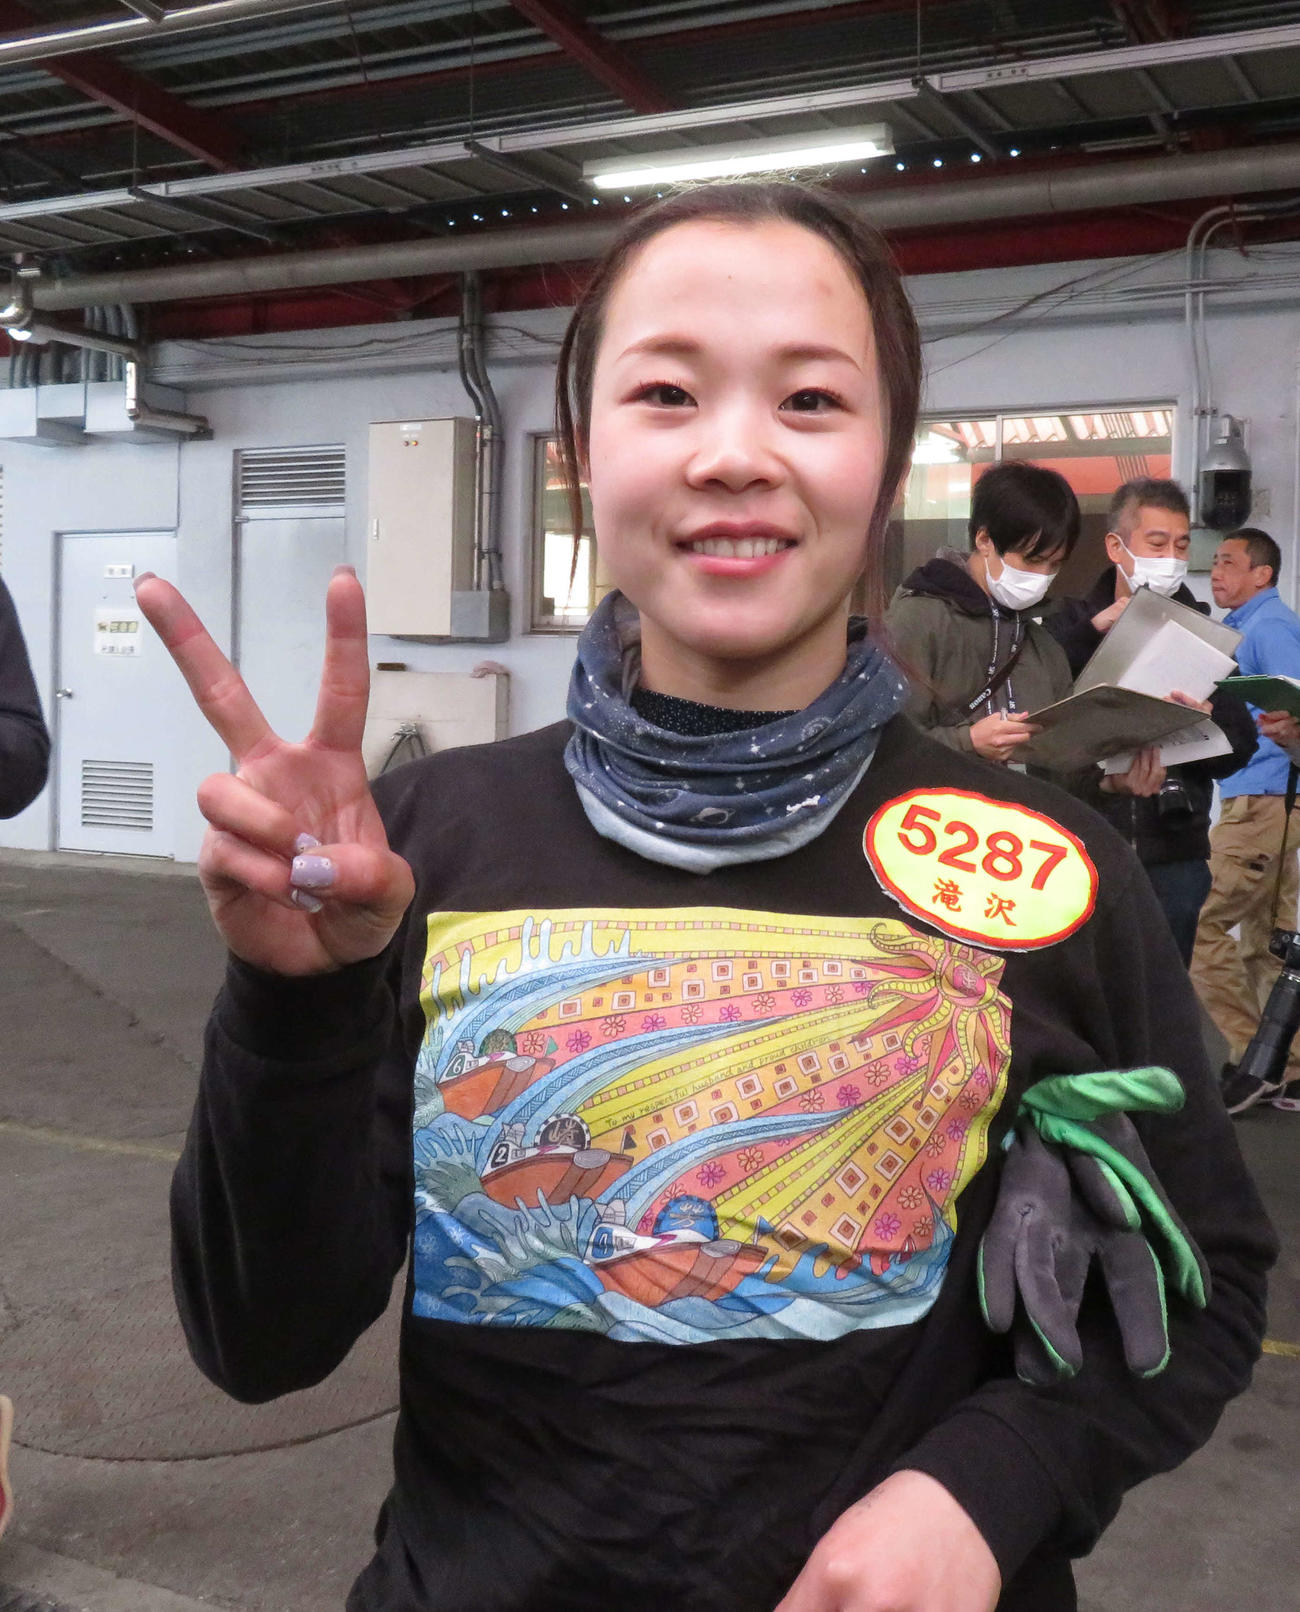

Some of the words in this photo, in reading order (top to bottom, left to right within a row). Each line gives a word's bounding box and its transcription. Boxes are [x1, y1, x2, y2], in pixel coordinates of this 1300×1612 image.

[969, 688, 992, 710] Canon
[897, 804, 1068, 890] 5287
[932, 877, 1017, 927] 滝沢
[452, 1057, 462, 1074] 6
[737, 1060, 754, 1073] and
[760, 1048, 785, 1064] proud
[495, 1146, 507, 1163] 2
